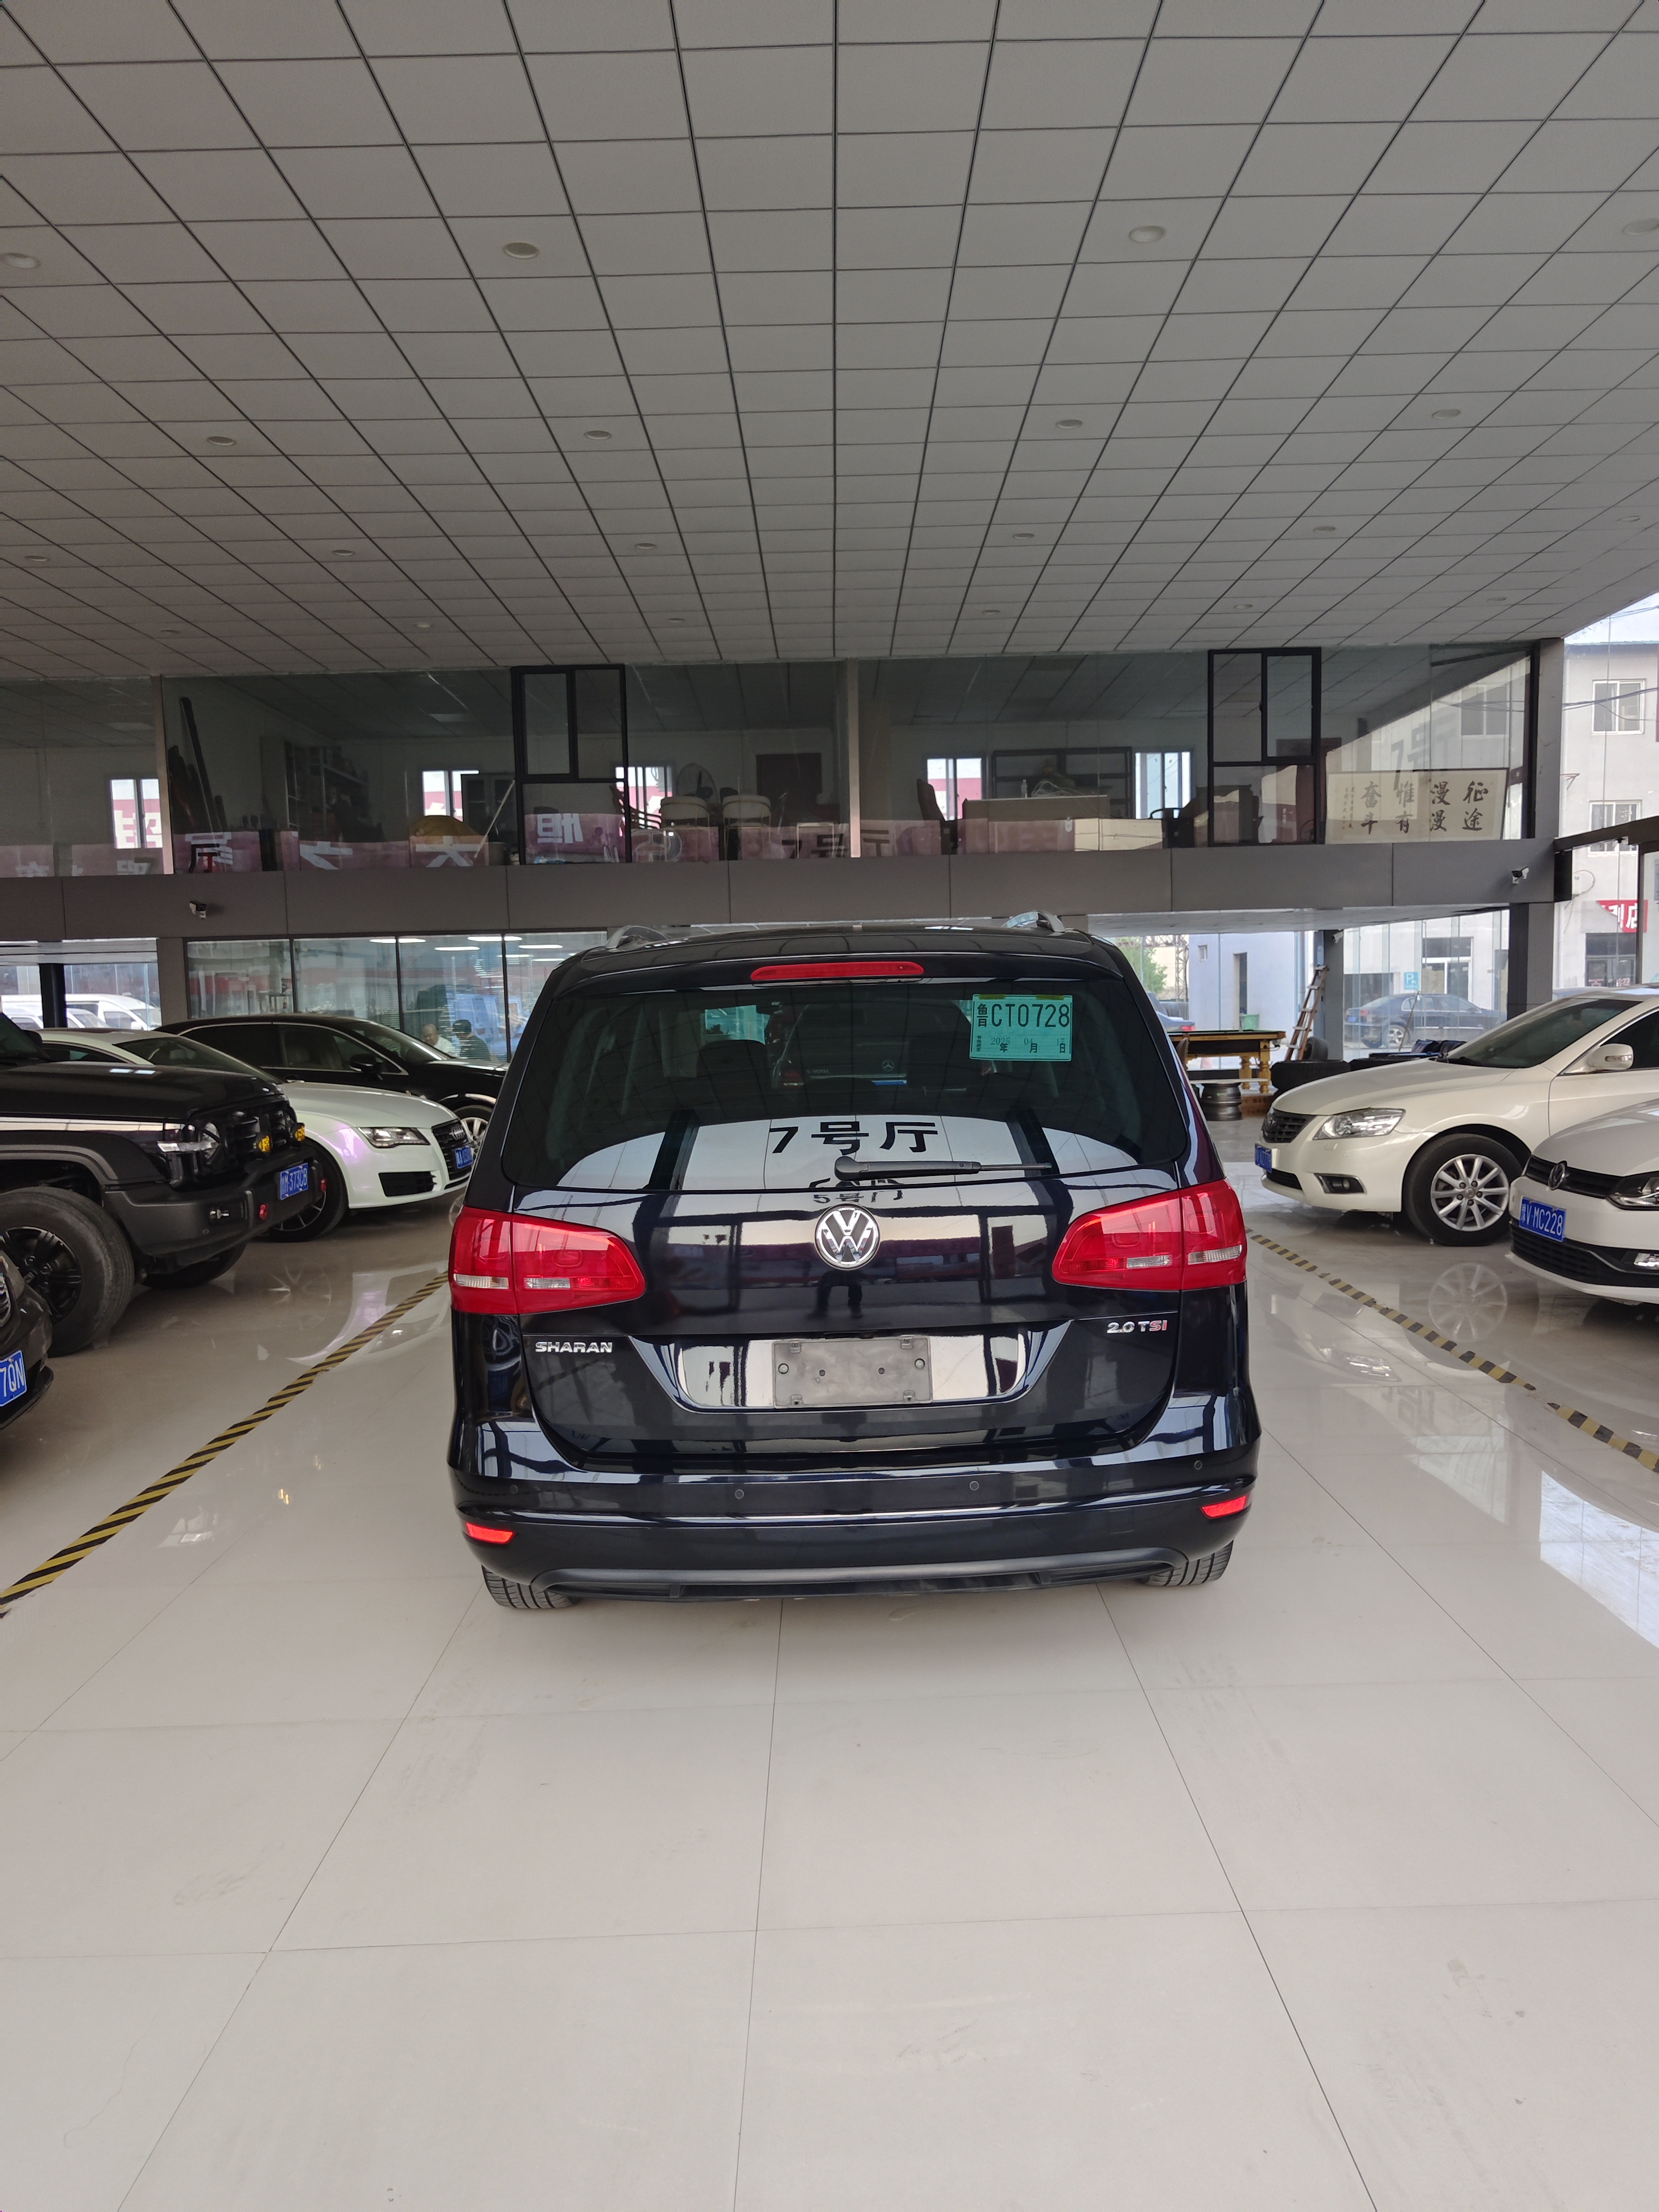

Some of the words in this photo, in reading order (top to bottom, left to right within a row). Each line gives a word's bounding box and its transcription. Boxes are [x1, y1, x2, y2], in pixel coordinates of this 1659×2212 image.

[977, 1003, 1069, 1027] 鲁CT0728
[769, 1121, 938, 1155] 7号厅
[1107, 1321, 1135, 1334] 2.0
[1138, 1320, 1168, 1332] TSI
[535, 1341, 613, 1353] SHARAN
